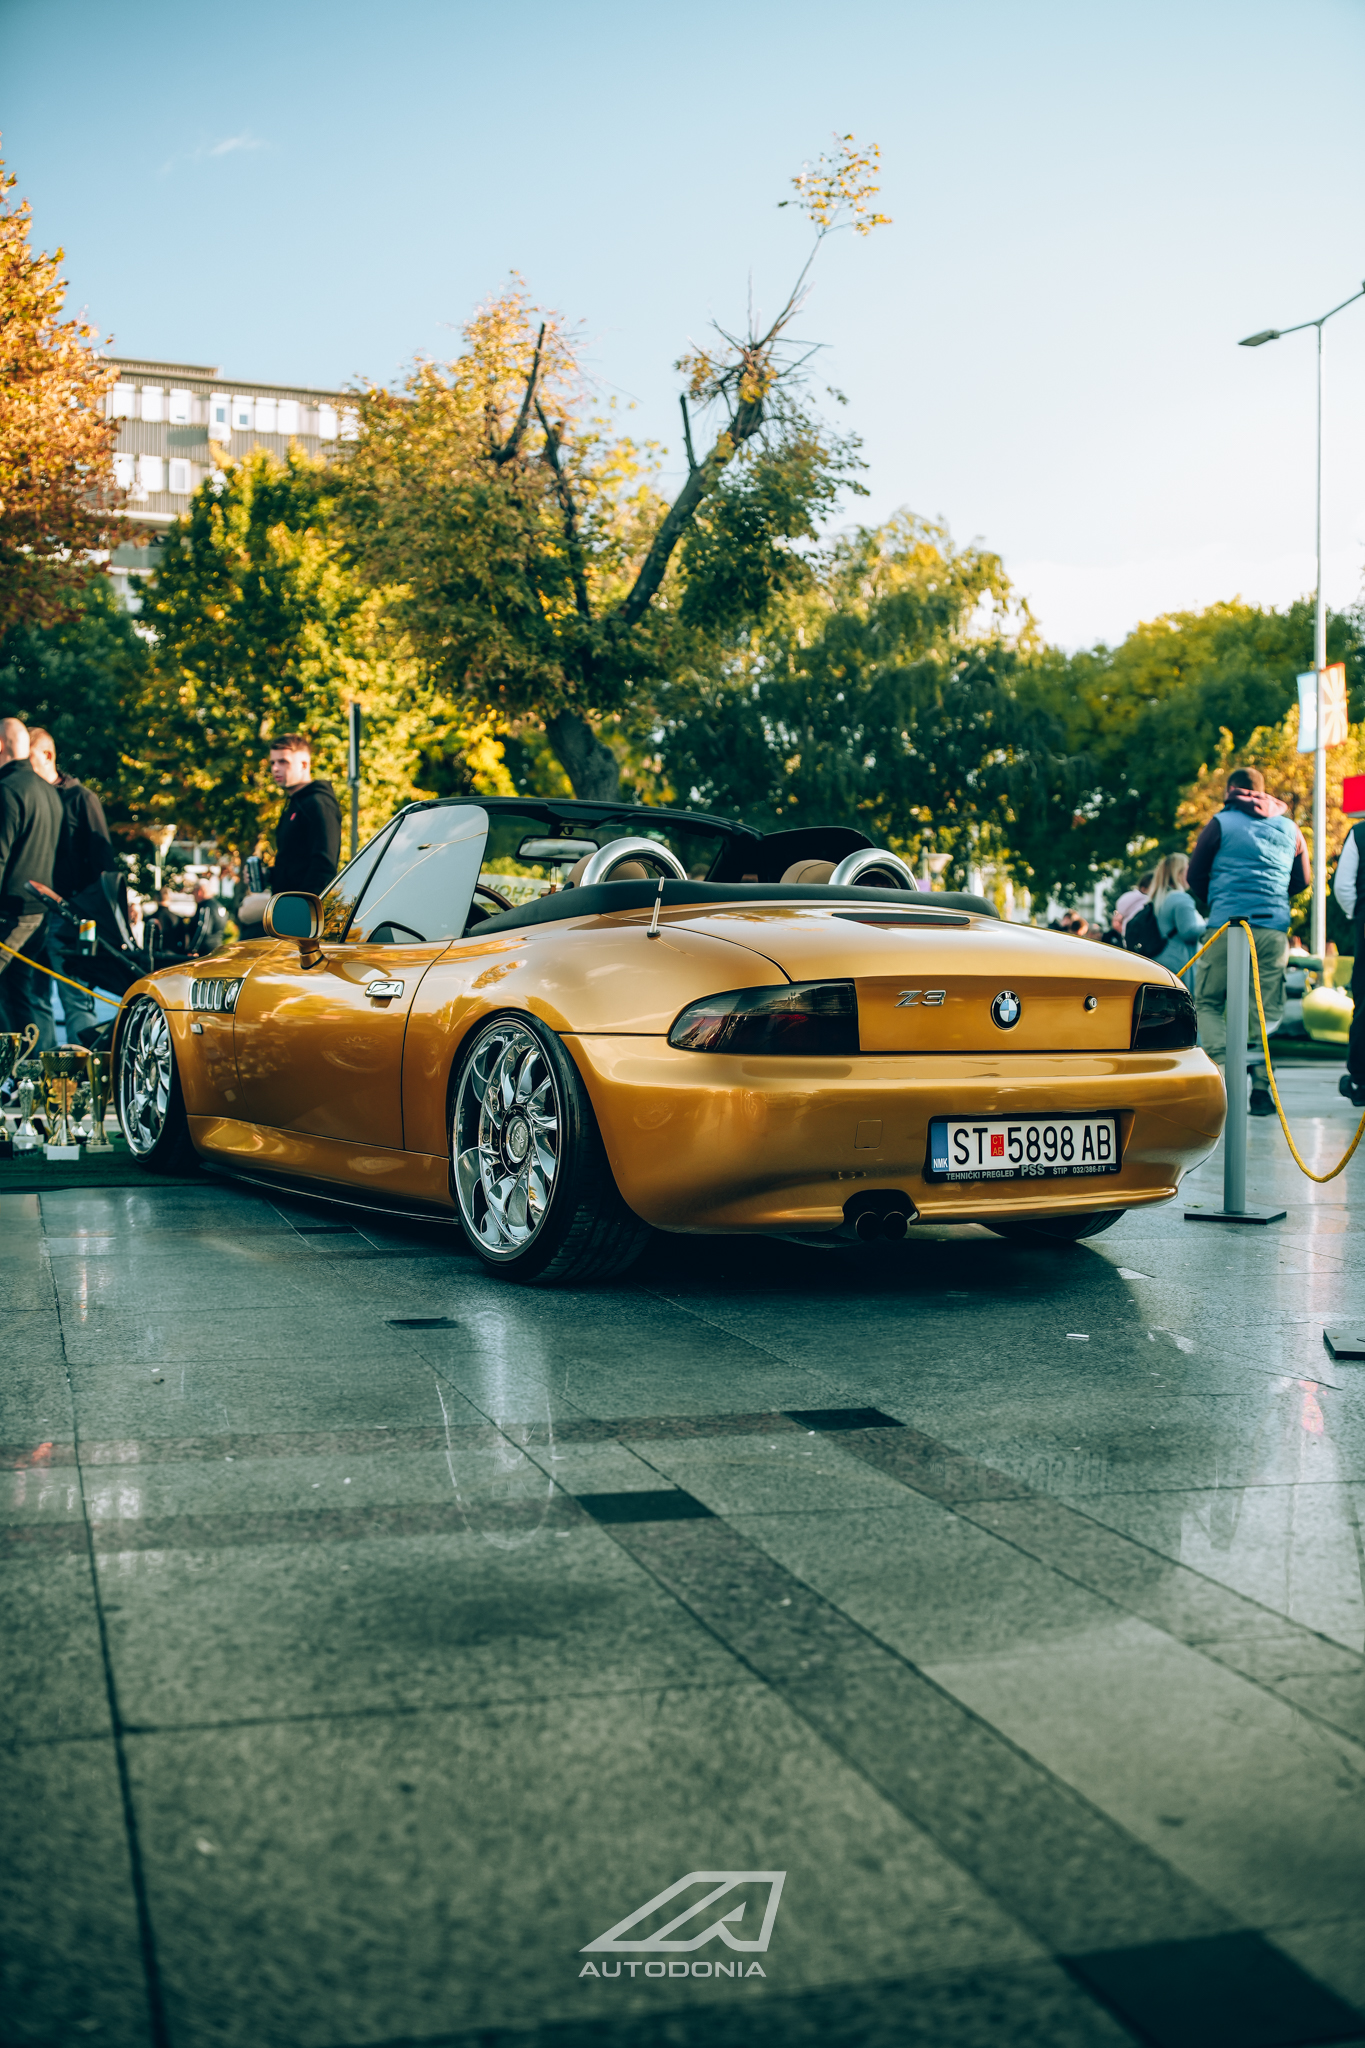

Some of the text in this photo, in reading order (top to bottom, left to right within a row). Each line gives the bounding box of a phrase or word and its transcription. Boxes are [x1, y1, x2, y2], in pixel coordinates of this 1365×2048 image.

[895, 990, 946, 1007] Z3
[996, 992, 1020, 1004] BMW
[953, 1124, 1112, 1165] ST 5898 AB
[933, 1158, 948, 1168] NMK
[946, 1170, 980, 1180] TEHNIČKI
[982, 1165, 1014, 1178] PREGLED
[1021, 1163, 1045, 1176] PSS
[1053, 1166, 1068, 1175] ŠTIP
